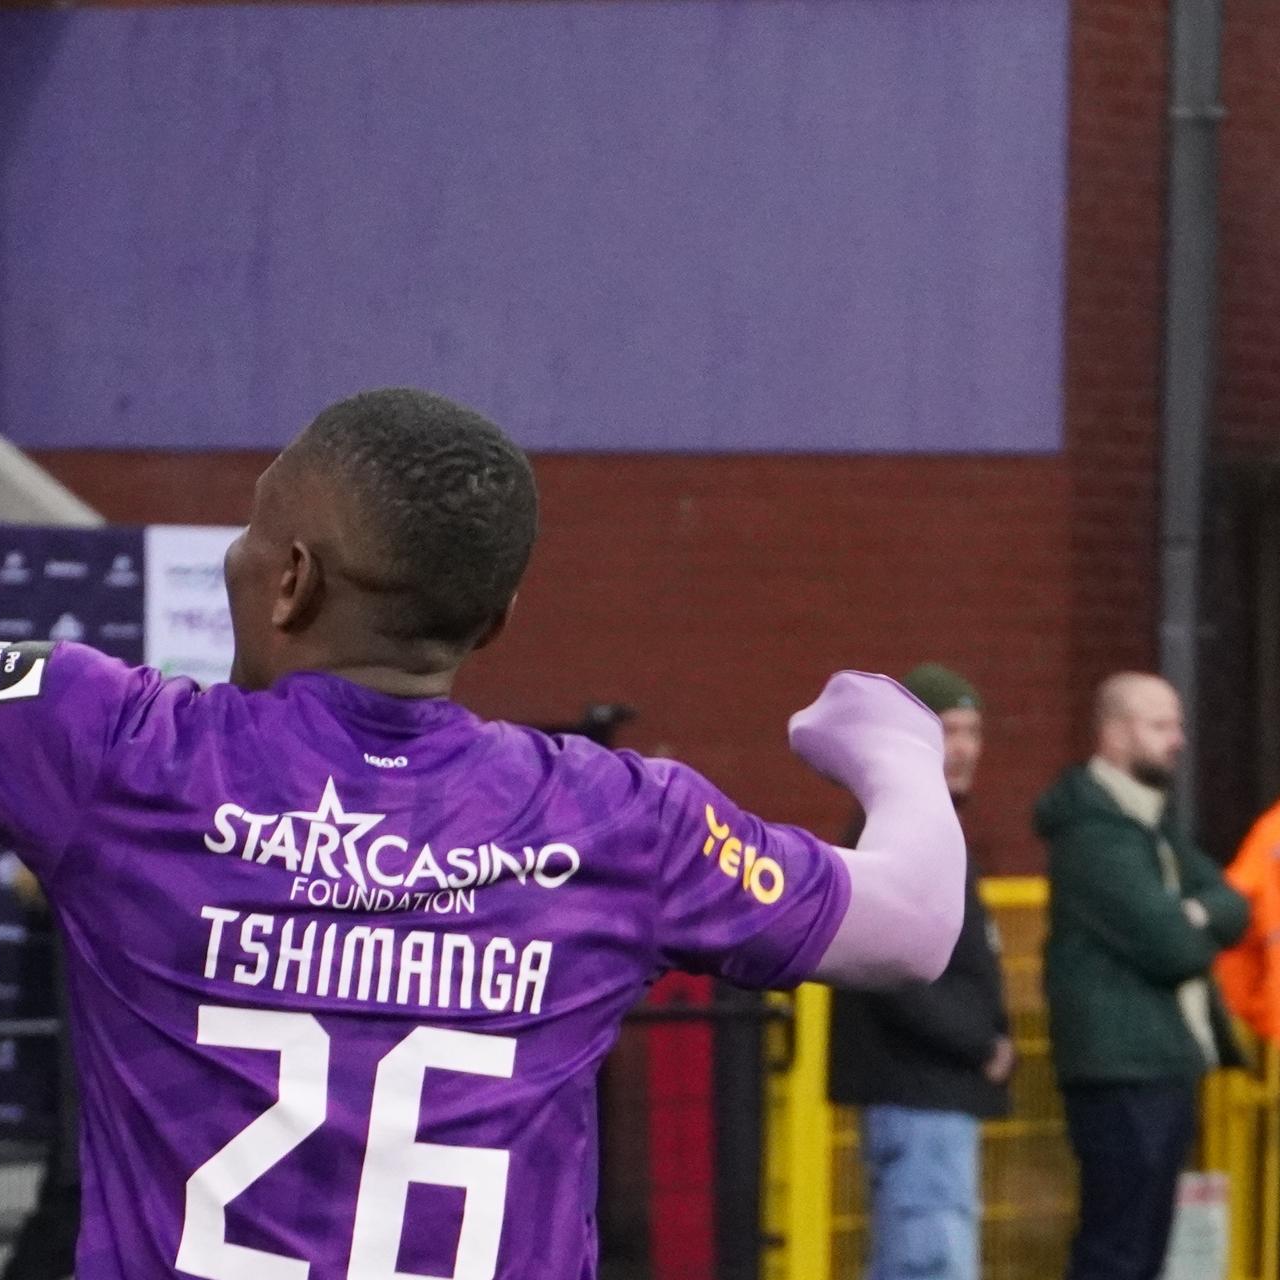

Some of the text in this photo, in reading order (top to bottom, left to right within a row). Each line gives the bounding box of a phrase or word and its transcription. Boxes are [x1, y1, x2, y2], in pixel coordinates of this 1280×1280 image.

[4, 651, 20, 673] Pro
[290, 876, 475, 915] FOUNDATION
[200, 905, 553, 1015] TSHIMANGA
